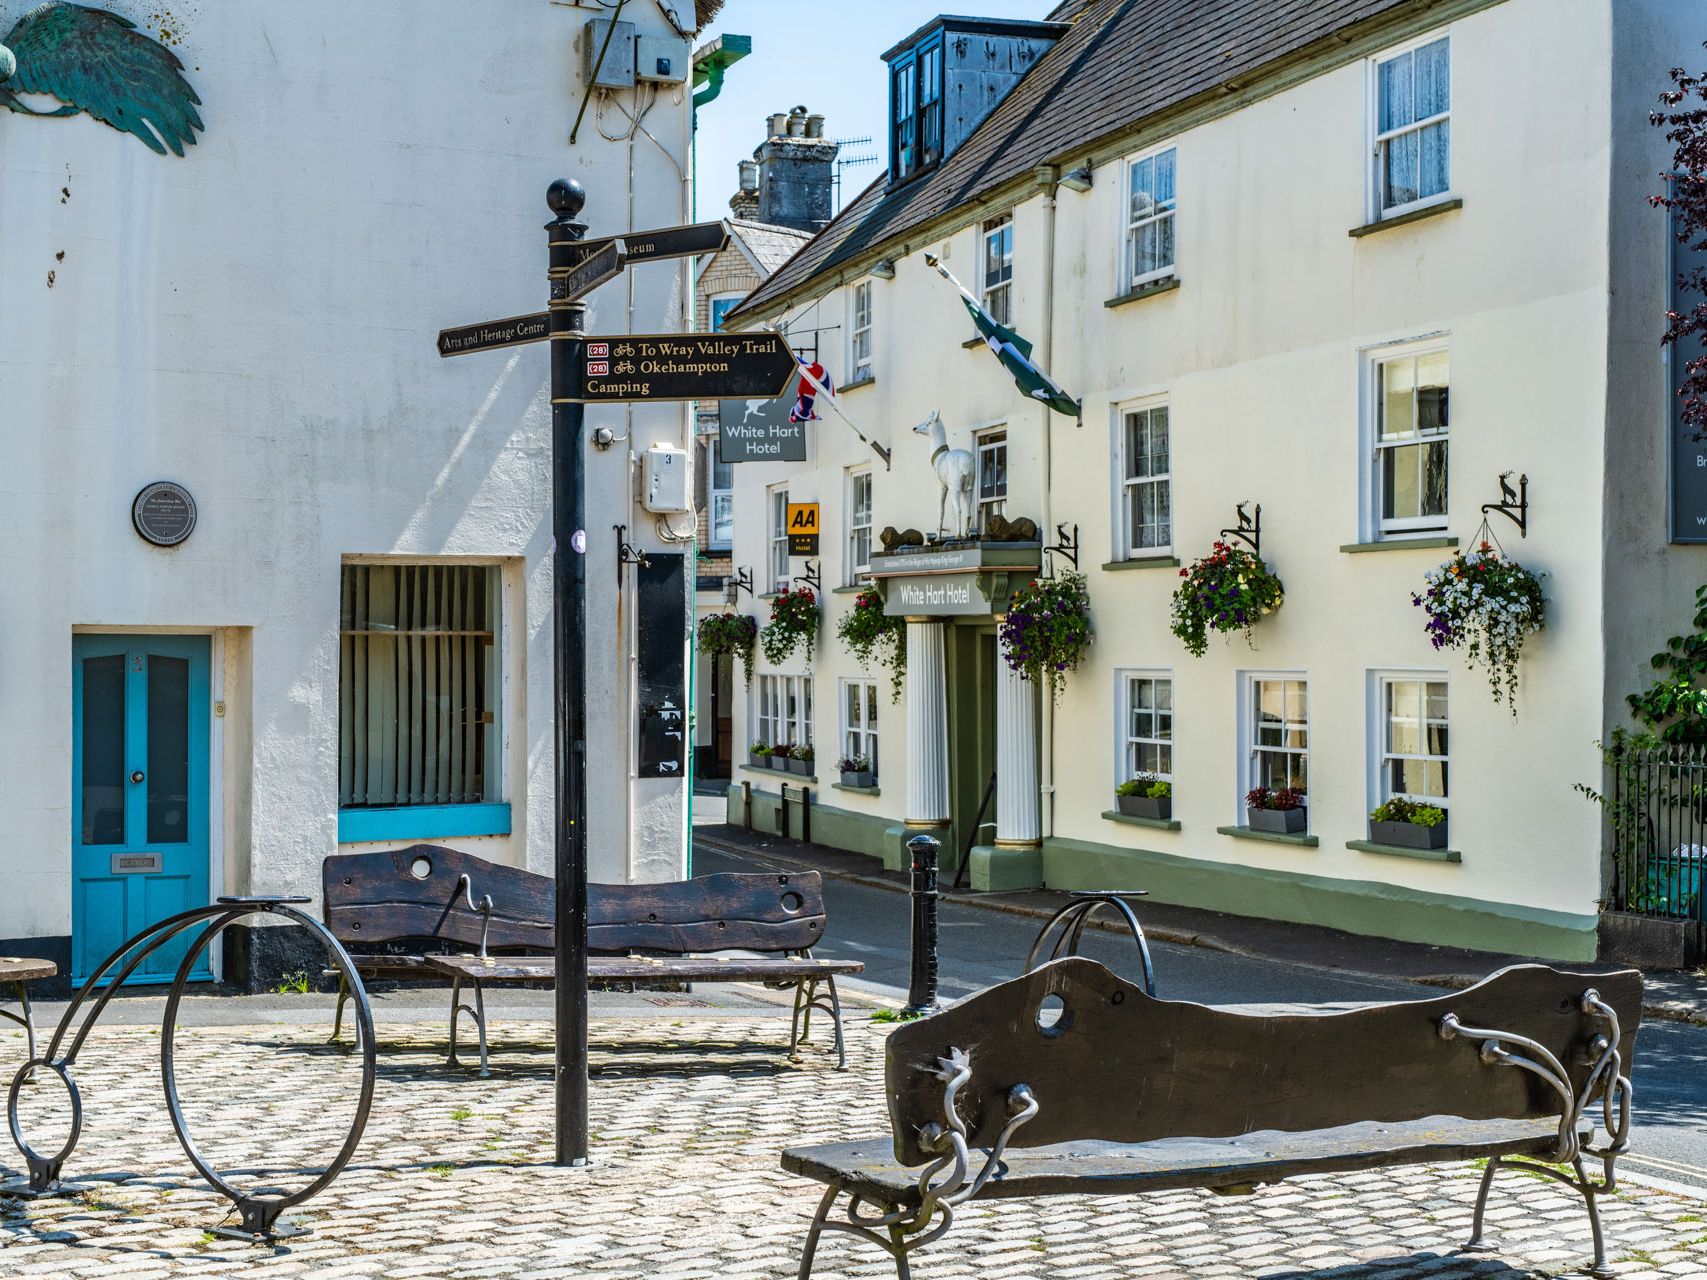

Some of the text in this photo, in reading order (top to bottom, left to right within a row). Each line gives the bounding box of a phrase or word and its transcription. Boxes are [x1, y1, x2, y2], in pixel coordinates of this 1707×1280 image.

[443, 322, 545, 349] Arts and Heritage Centre
[639, 344, 656, 356] To
[659, 343, 694, 359] Wray
[697, 341, 740, 357] Valley
[742, 340, 777, 354] Trail
[640, 360, 729, 376] Okehampton
[587, 380, 650, 395] Camping
[725, 424, 799, 438] White Hart
[746, 441, 780, 454] Hotel
[665, 454, 672, 465] 3
[791, 509, 815, 528] AA
[900, 582, 970, 605] White Hart Hotel
